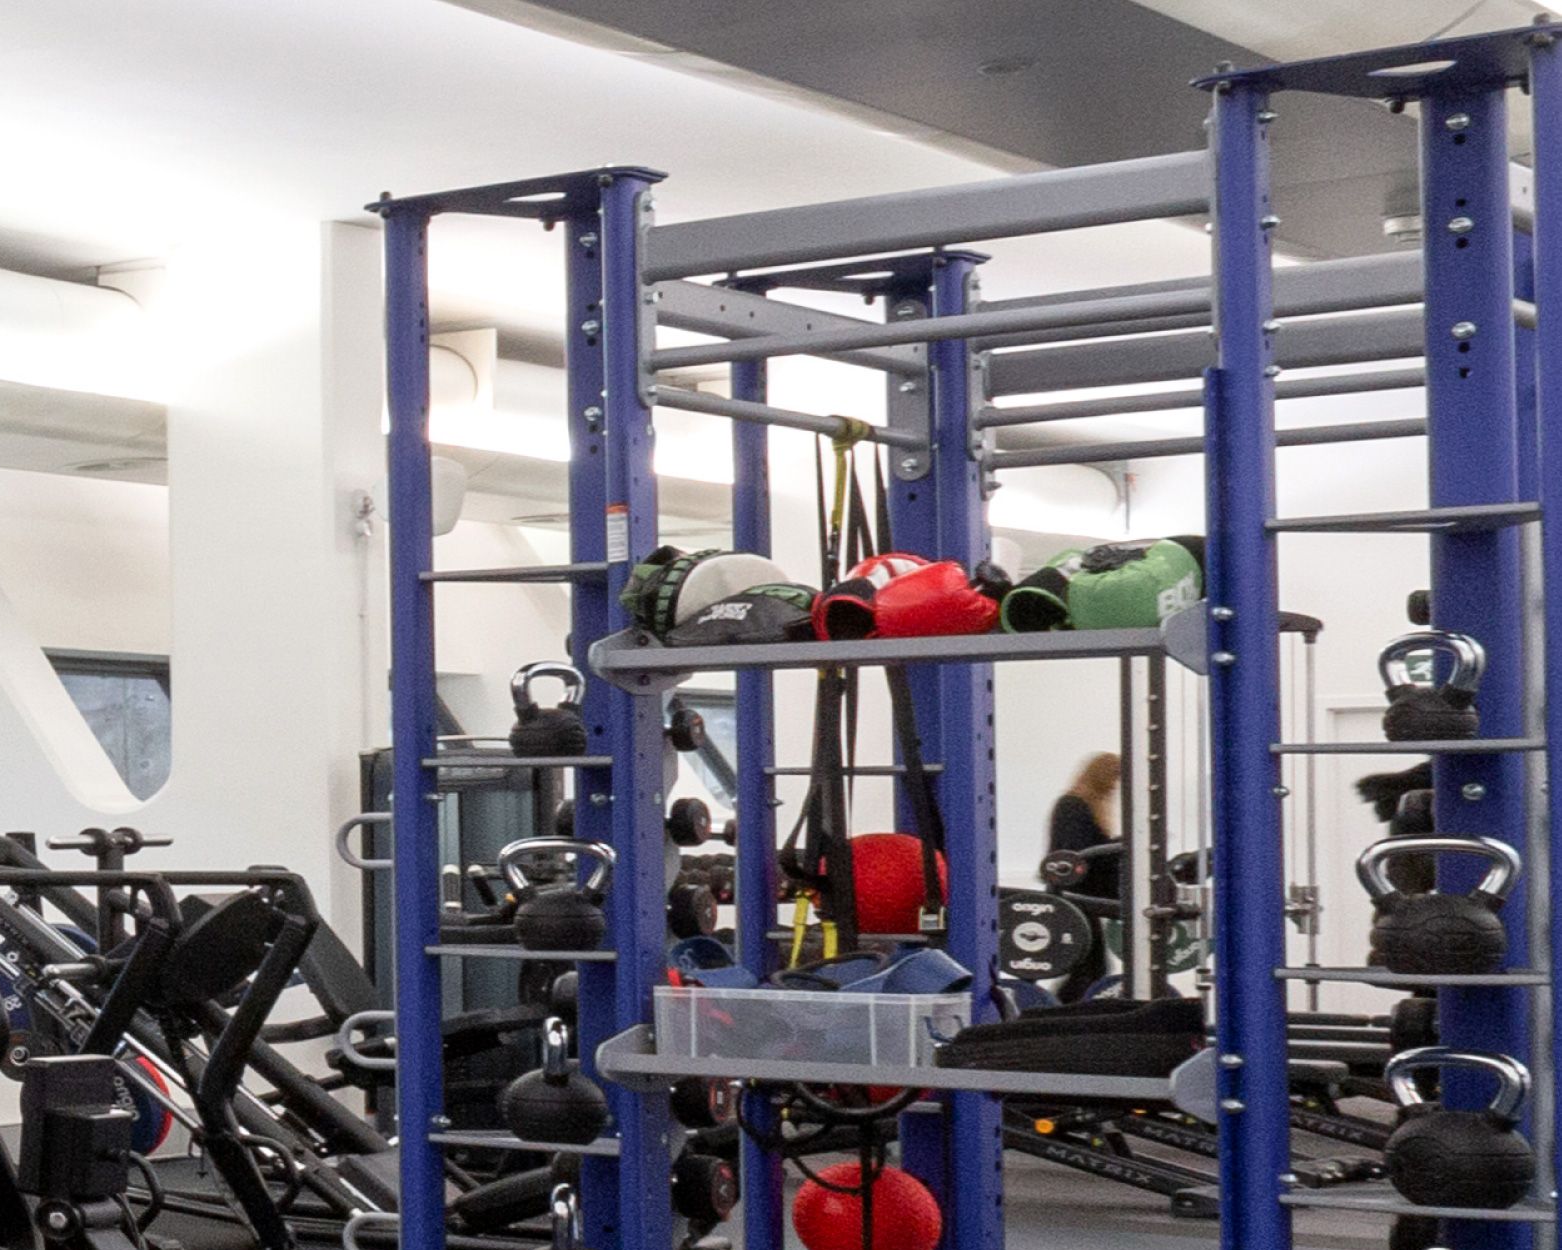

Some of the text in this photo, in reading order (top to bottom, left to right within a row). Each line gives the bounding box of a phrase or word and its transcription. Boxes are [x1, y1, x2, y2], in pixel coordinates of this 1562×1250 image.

[1012, 902, 1055, 916] origin
[1143, 1125, 1219, 1153] MATR
[1046, 1144, 1153, 1185] MATRIX
